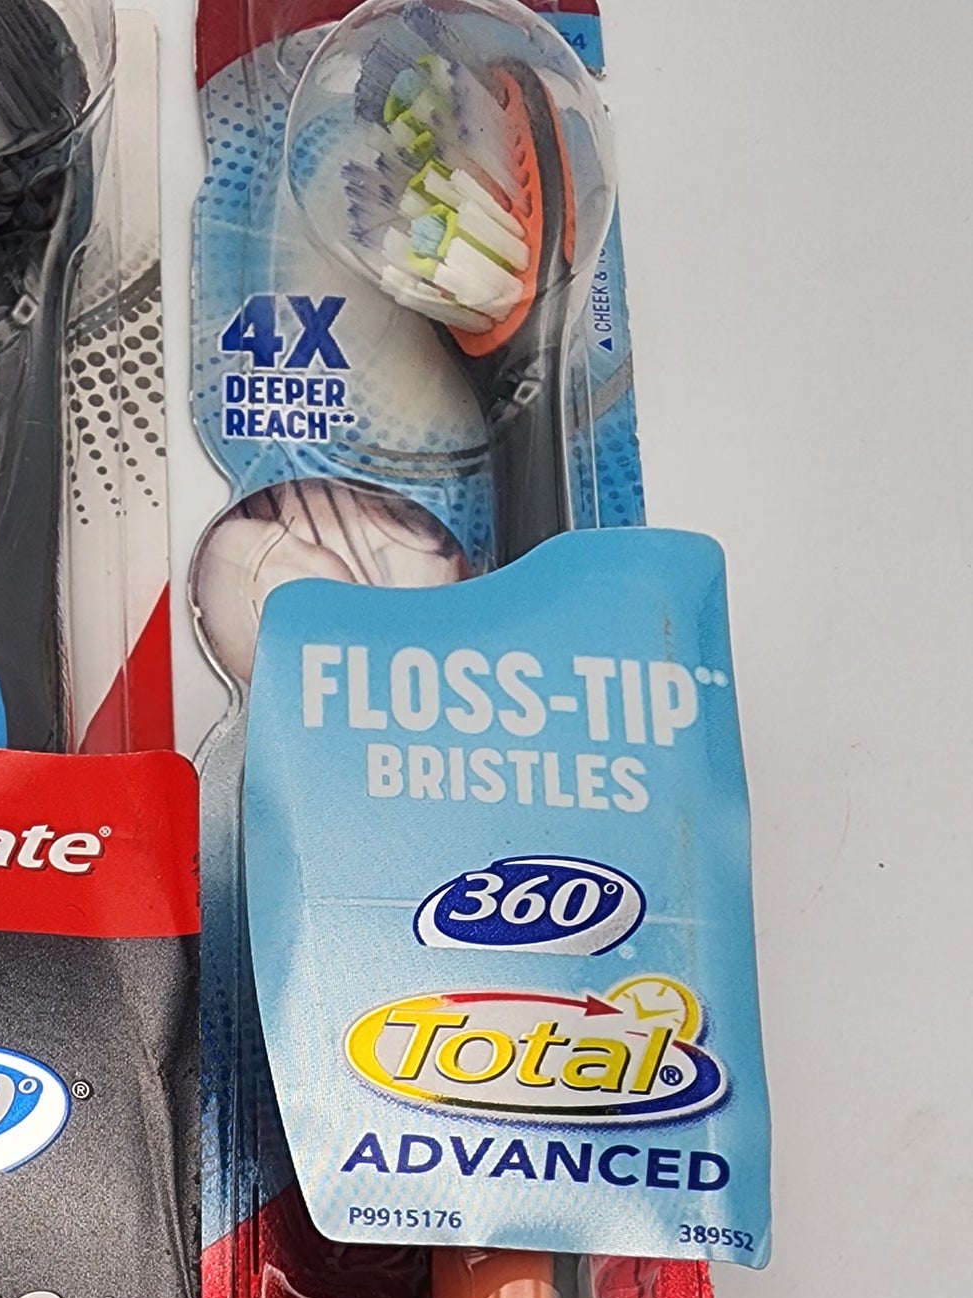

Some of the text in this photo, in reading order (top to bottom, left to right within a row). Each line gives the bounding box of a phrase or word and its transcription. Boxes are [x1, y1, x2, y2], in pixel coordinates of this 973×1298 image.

[593, 271, 608, 281] &
[591, 285, 612, 332] CHEEK
[221, 295, 351, 370] 4X
[226, 375, 346, 408] DEEPER
[366, 743, 650, 813] BRISTLES
[340, 1132, 731, 1191] ADVANCED
[348, 1206, 462, 1230] P9915176
[678, 1223, 755, 1252] 389552
